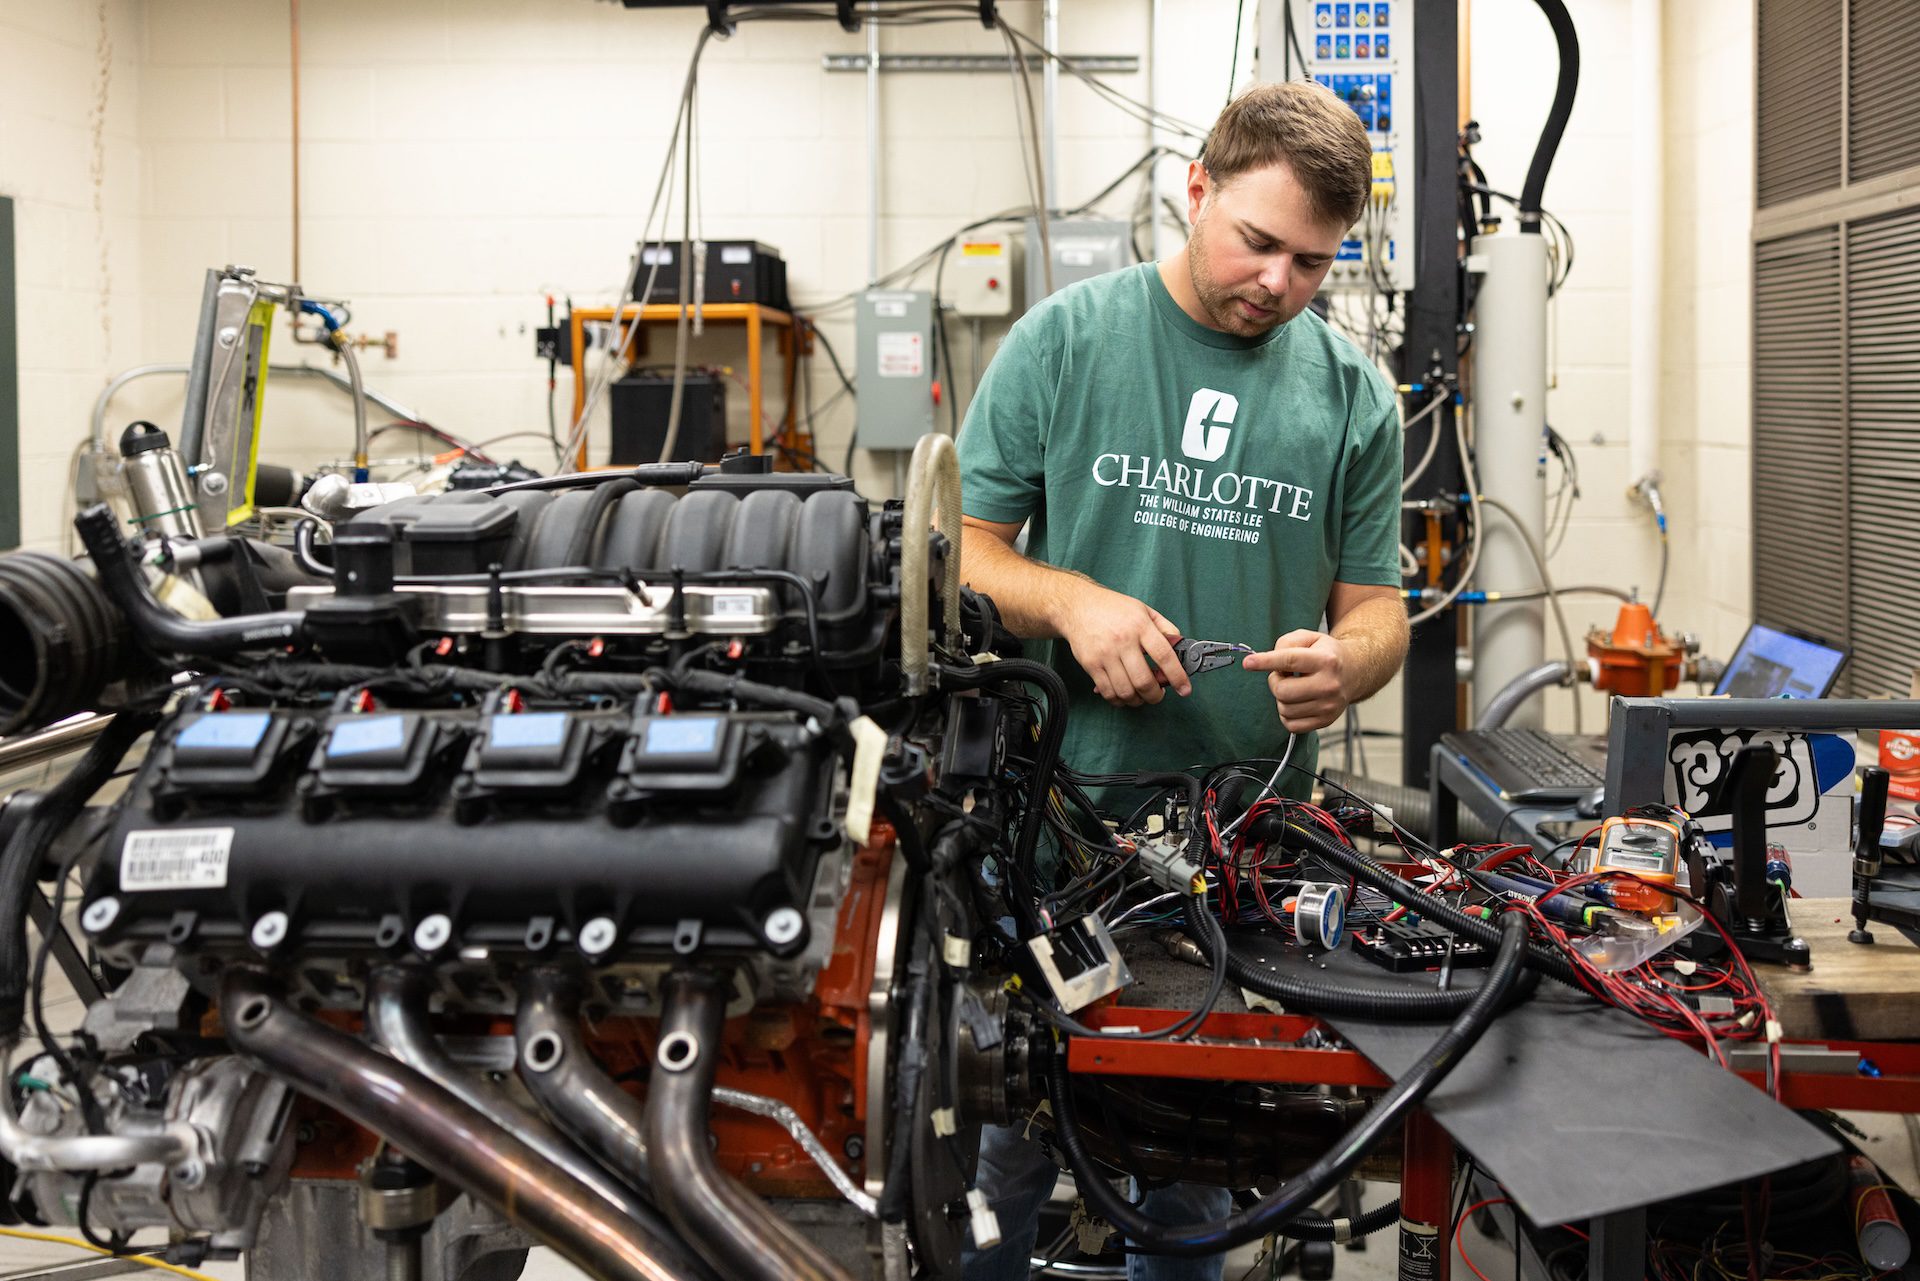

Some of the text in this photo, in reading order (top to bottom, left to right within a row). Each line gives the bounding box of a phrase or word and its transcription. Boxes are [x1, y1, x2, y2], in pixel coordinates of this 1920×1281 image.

[1091, 453, 1314, 522] CHARLOTTE
[1133, 510, 1260, 545] COLLEGE OF ENGINEERING
[1139, 493, 1264, 528] THE WILLIAM STATES LEE
